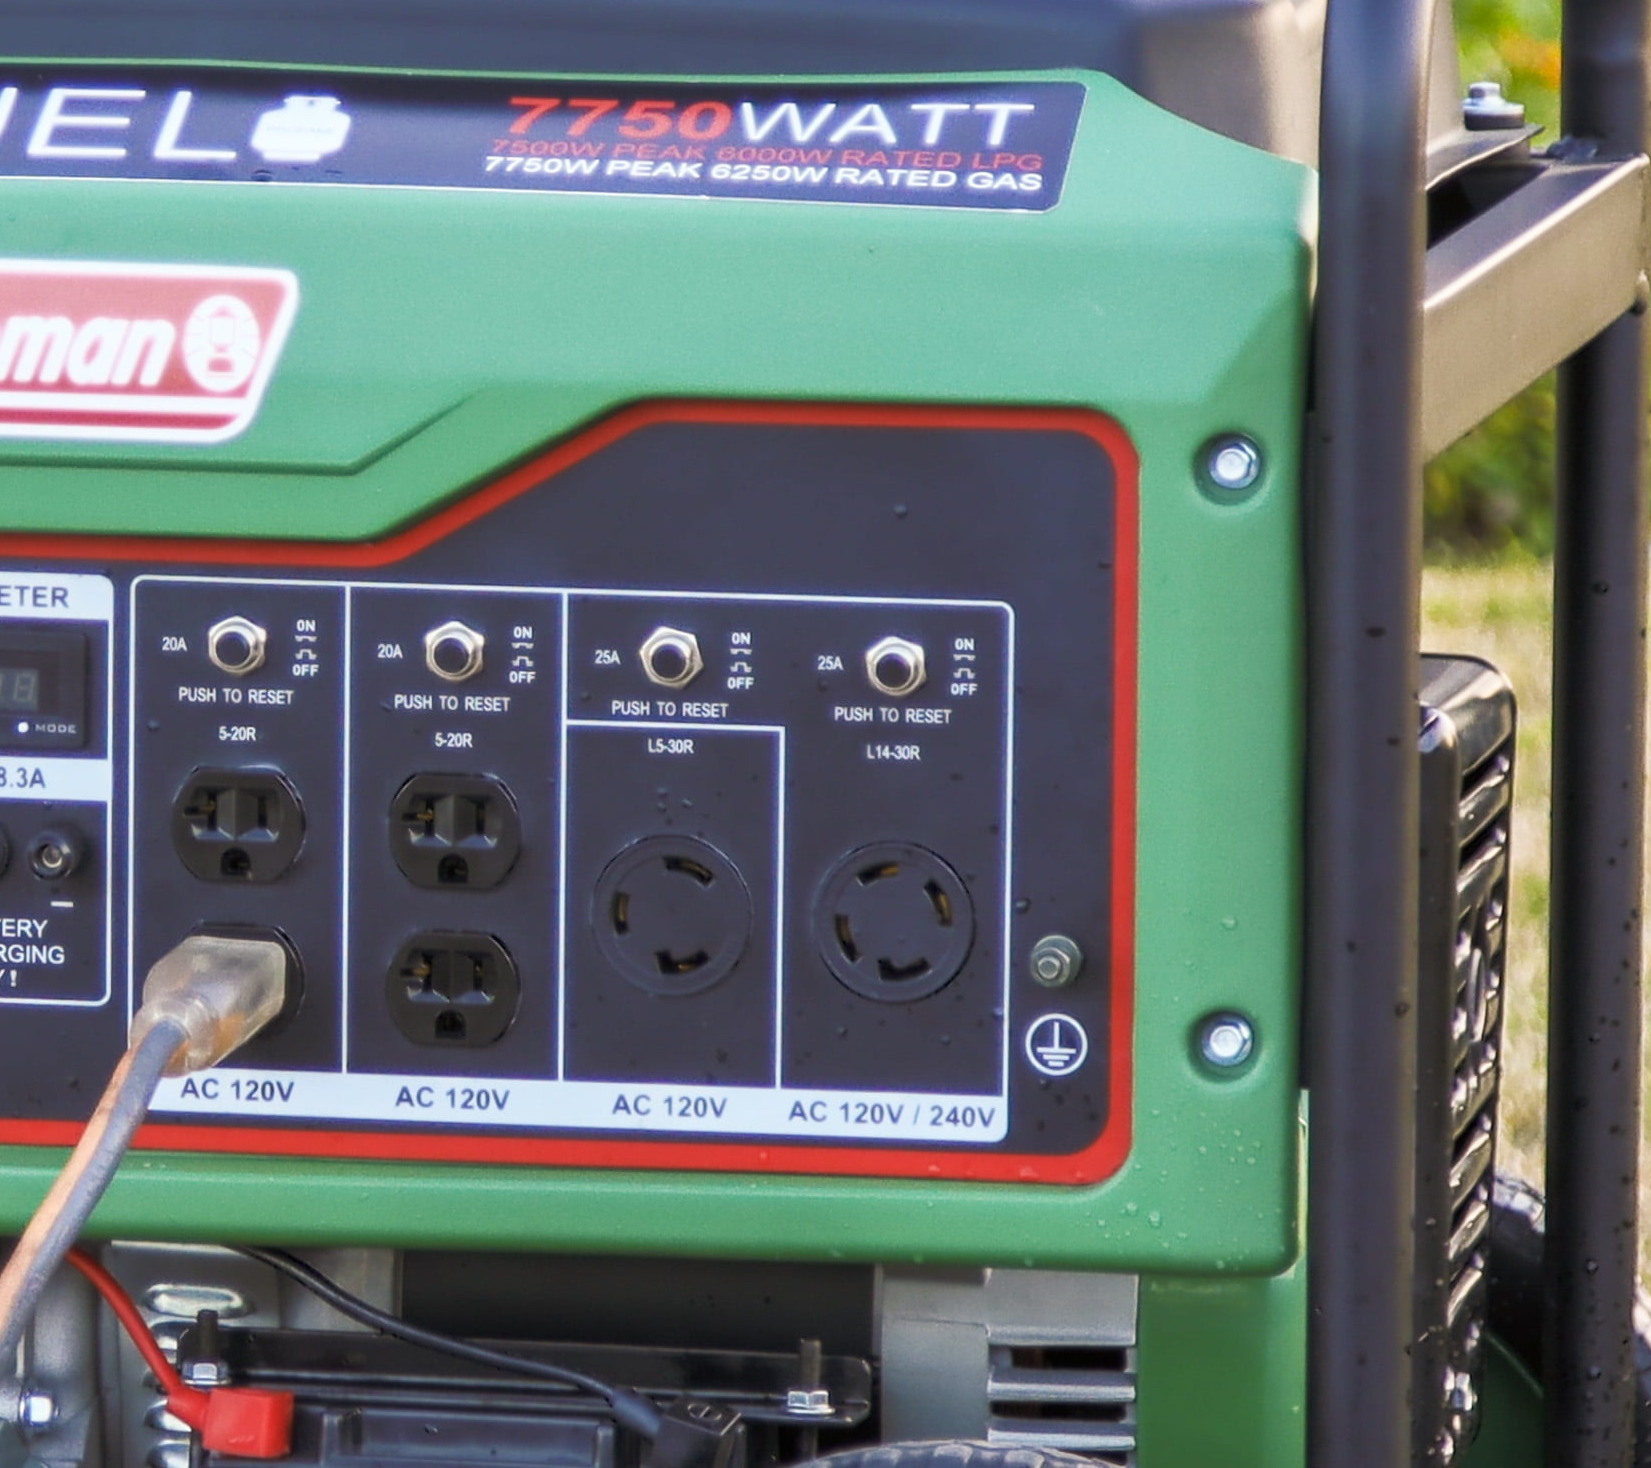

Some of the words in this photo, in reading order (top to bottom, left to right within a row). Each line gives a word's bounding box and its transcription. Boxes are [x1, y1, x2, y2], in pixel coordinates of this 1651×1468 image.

[494, 138, 604, 158] 7500W
[615, 142, 706, 162] PEAK
[842, 149, 962, 170] RATED
[972, 152, 1043, 171] LPG
[485, 154, 600, 176] 7750W
[607, 158, 702, 180] PEAK
[712, 162, 828, 184] 6250W
[835, 166, 957, 189] RATED
[968, 170, 1042, 192] GAS
[296, 619, 316, 633] ON
[513, 626, 533, 639] ON
[162, 637, 188, 652] 20A
[731, 632, 752, 645] ON
[954, 638, 975, 651] ON
[377, 643, 403, 659] 20A
[595, 650, 621, 665] 25A
[292, 663, 319, 677] OFF
[818, 656, 844, 671] 25A
[509, 670, 536, 684] OFF
[727, 676, 755, 690] OFF
[178, 686, 216, 703] PUSH
[223, 687, 242, 704] TO
[248, 688, 294, 706] RESET
[950, 683, 978, 696] OFF
[394, 693, 433, 711] PUSH
[439, 695, 459, 711] TO
[464, 696, 511, 713] RESET
[611, 699, 651, 717] PUSH
[657, 701, 677, 718] TO
[682, 702, 729, 719] RESET
[834, 706, 874, 723] PUSH
[880, 707, 900, 724] TO
[905, 708, 952, 725] RESET
[34, 723, 77, 734] MODE
[219, 725, 257, 742] 5-20R
[434, 732, 473, 749] 5-20R
[648, 738, 695, 755] L5-30R
[866, 744, 921, 762] L14-30R
[181, 1078, 224, 1103] AC
[234, 1079, 296, 1104] 120V
[395, 1085, 439, 1110] AC
[449, 1087, 511, 1113] 120V
[612, 1092, 656, 1117] AC
[666, 1094, 729, 1120] 120V
[788, 1099, 831, 1124] AC
[842, 1101, 906, 1127] 120V
[929, 1104, 997, 1130] 240V
